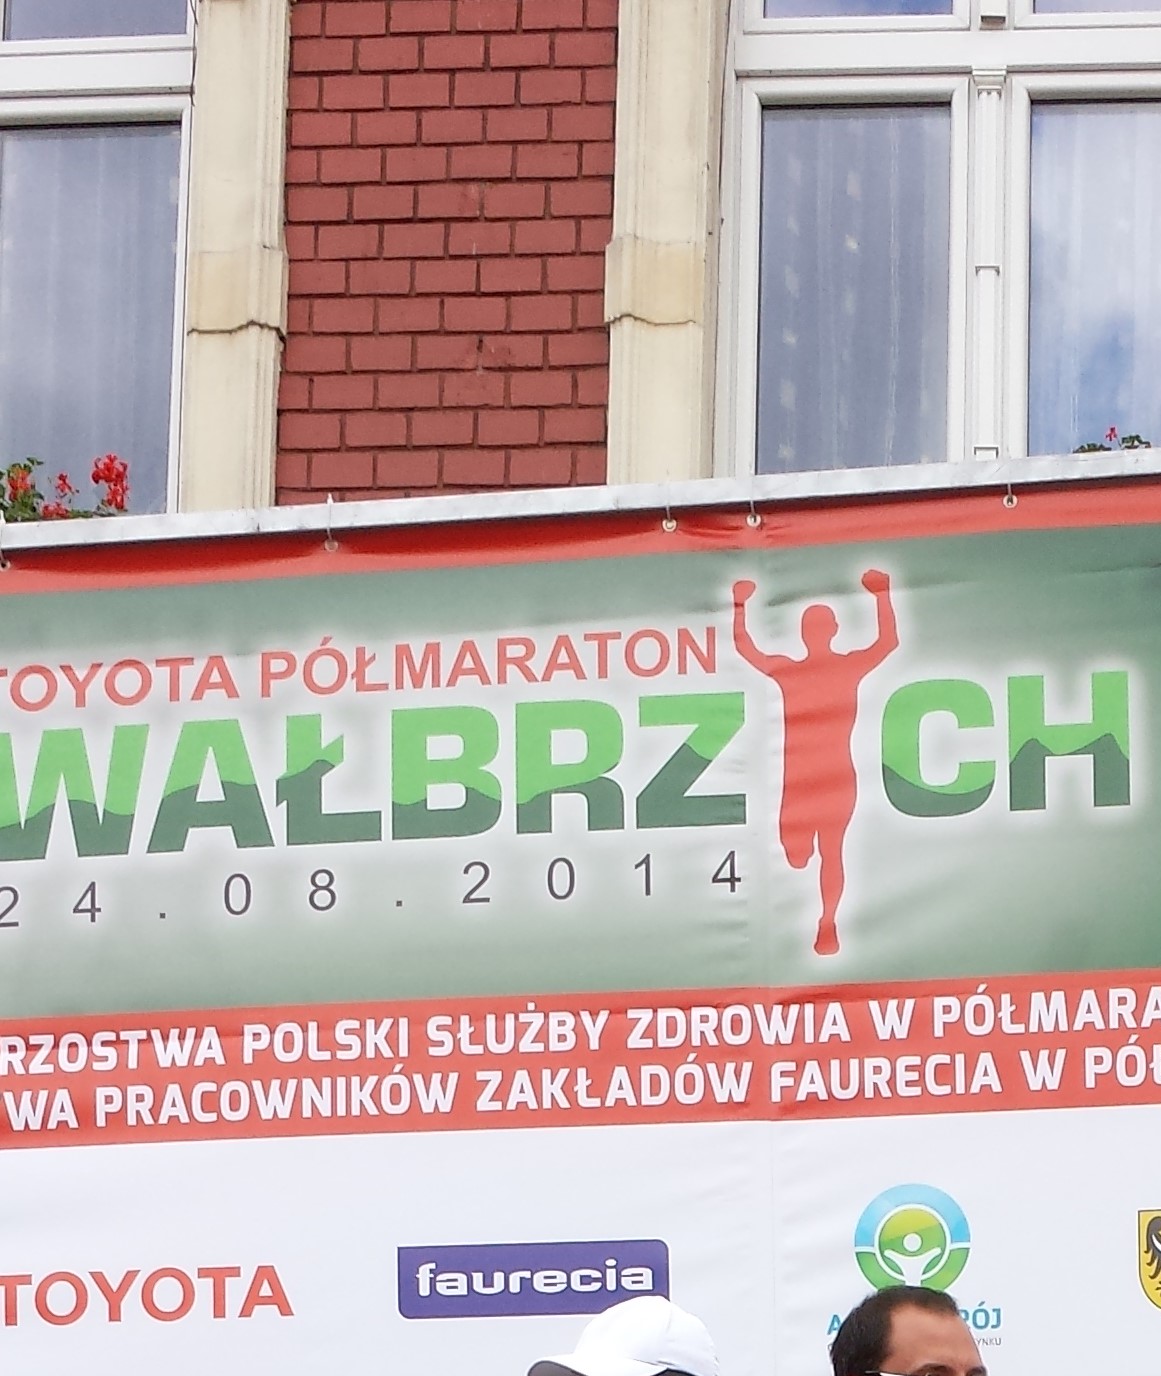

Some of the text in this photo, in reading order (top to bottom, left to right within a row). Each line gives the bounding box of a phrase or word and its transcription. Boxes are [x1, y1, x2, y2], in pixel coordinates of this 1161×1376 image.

[260, 625, 718, 699] PÓŁMARATON
[242, 1015, 410, 1065] POLSKI
[426, 1001, 610, 1058] SŁUŻBY
[626, 999, 852, 1050] ZDROWIA
[870, 998, 916, 1043] W
[95, 1064, 459, 1128] PRACOWNIKÓW
[475, 1052, 753, 1112] ZAKŁADÓW
[770, 1050, 1003, 1104] FAURECIA
[1019, 1048, 1066, 1092] W
[0, 1265, 294, 1326] TOYOTA
[416, 1258, 654, 1298] faurecia
